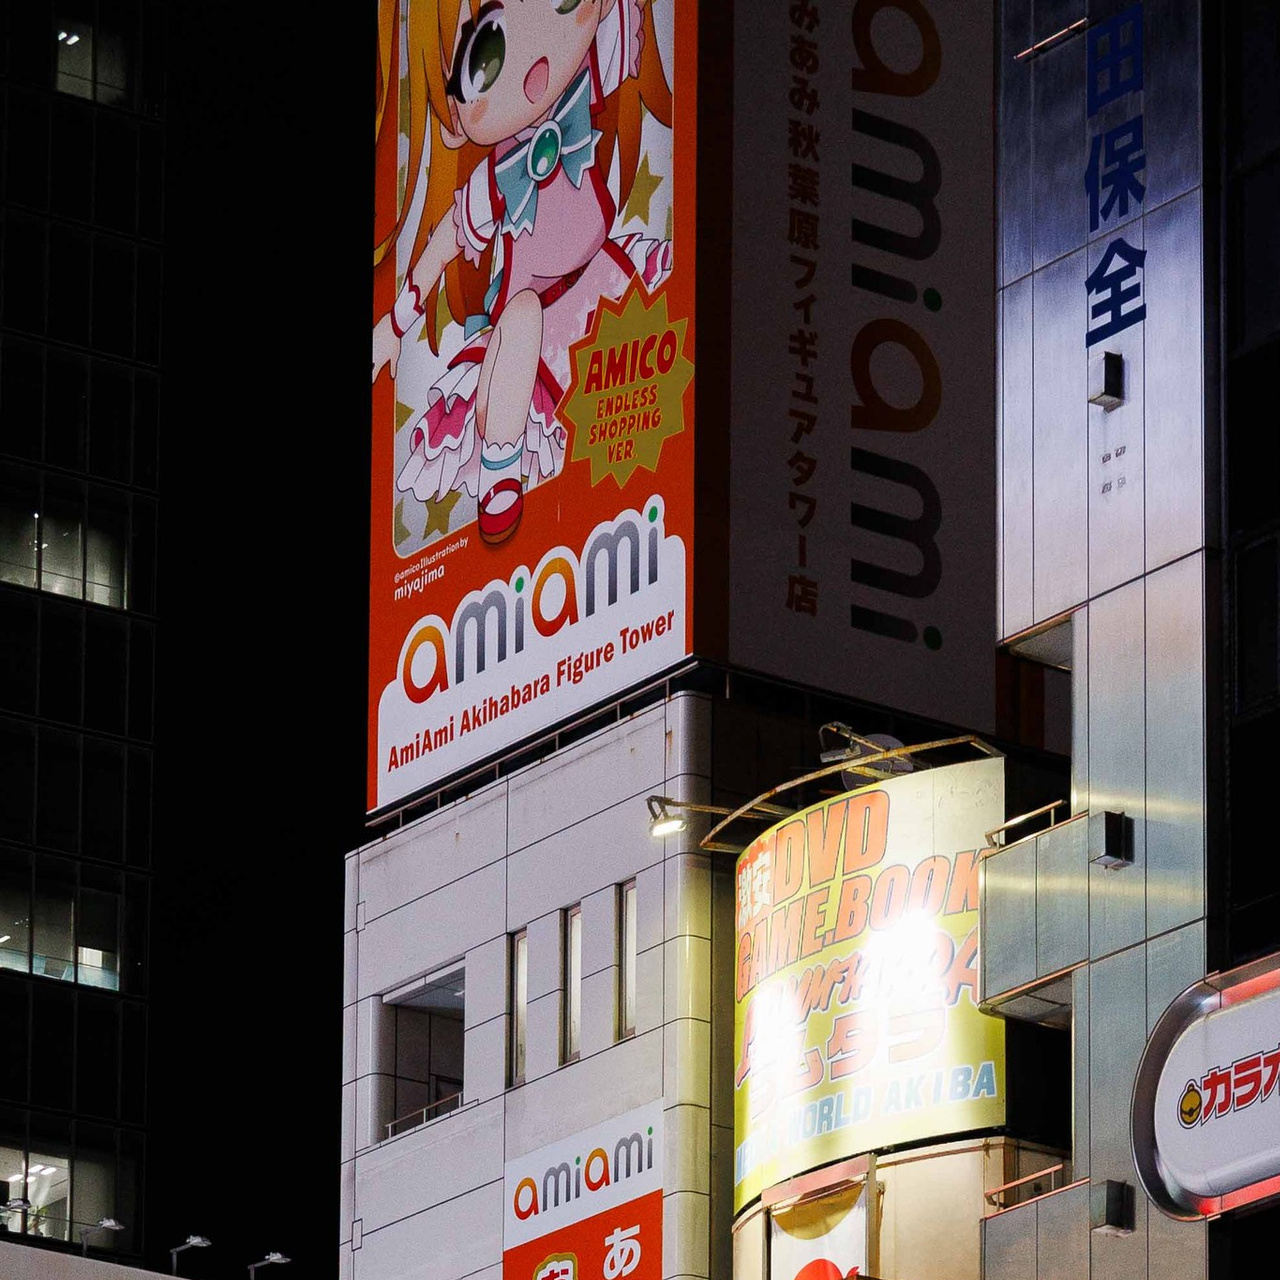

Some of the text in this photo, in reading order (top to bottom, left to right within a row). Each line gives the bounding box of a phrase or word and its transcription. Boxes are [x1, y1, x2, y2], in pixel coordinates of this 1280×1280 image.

[584, 329, 677, 394] AMICO
[588, 408, 662, 446] SHOPPING
[596, 385, 658, 421] ENDLESS
[607, 440, 637, 464] VER.
[459, 536, 469, 551] by
[393, 564, 445, 602] miyajima
[403, 505, 659, 704] amiami
[387, 609, 676, 772] AmiAmi Akihabara Figure Tower
[773, 789, 891, 906] DVD
[888, 1061, 997, 1112] AKIBA
[513, 1125, 655, 1220] amiami
